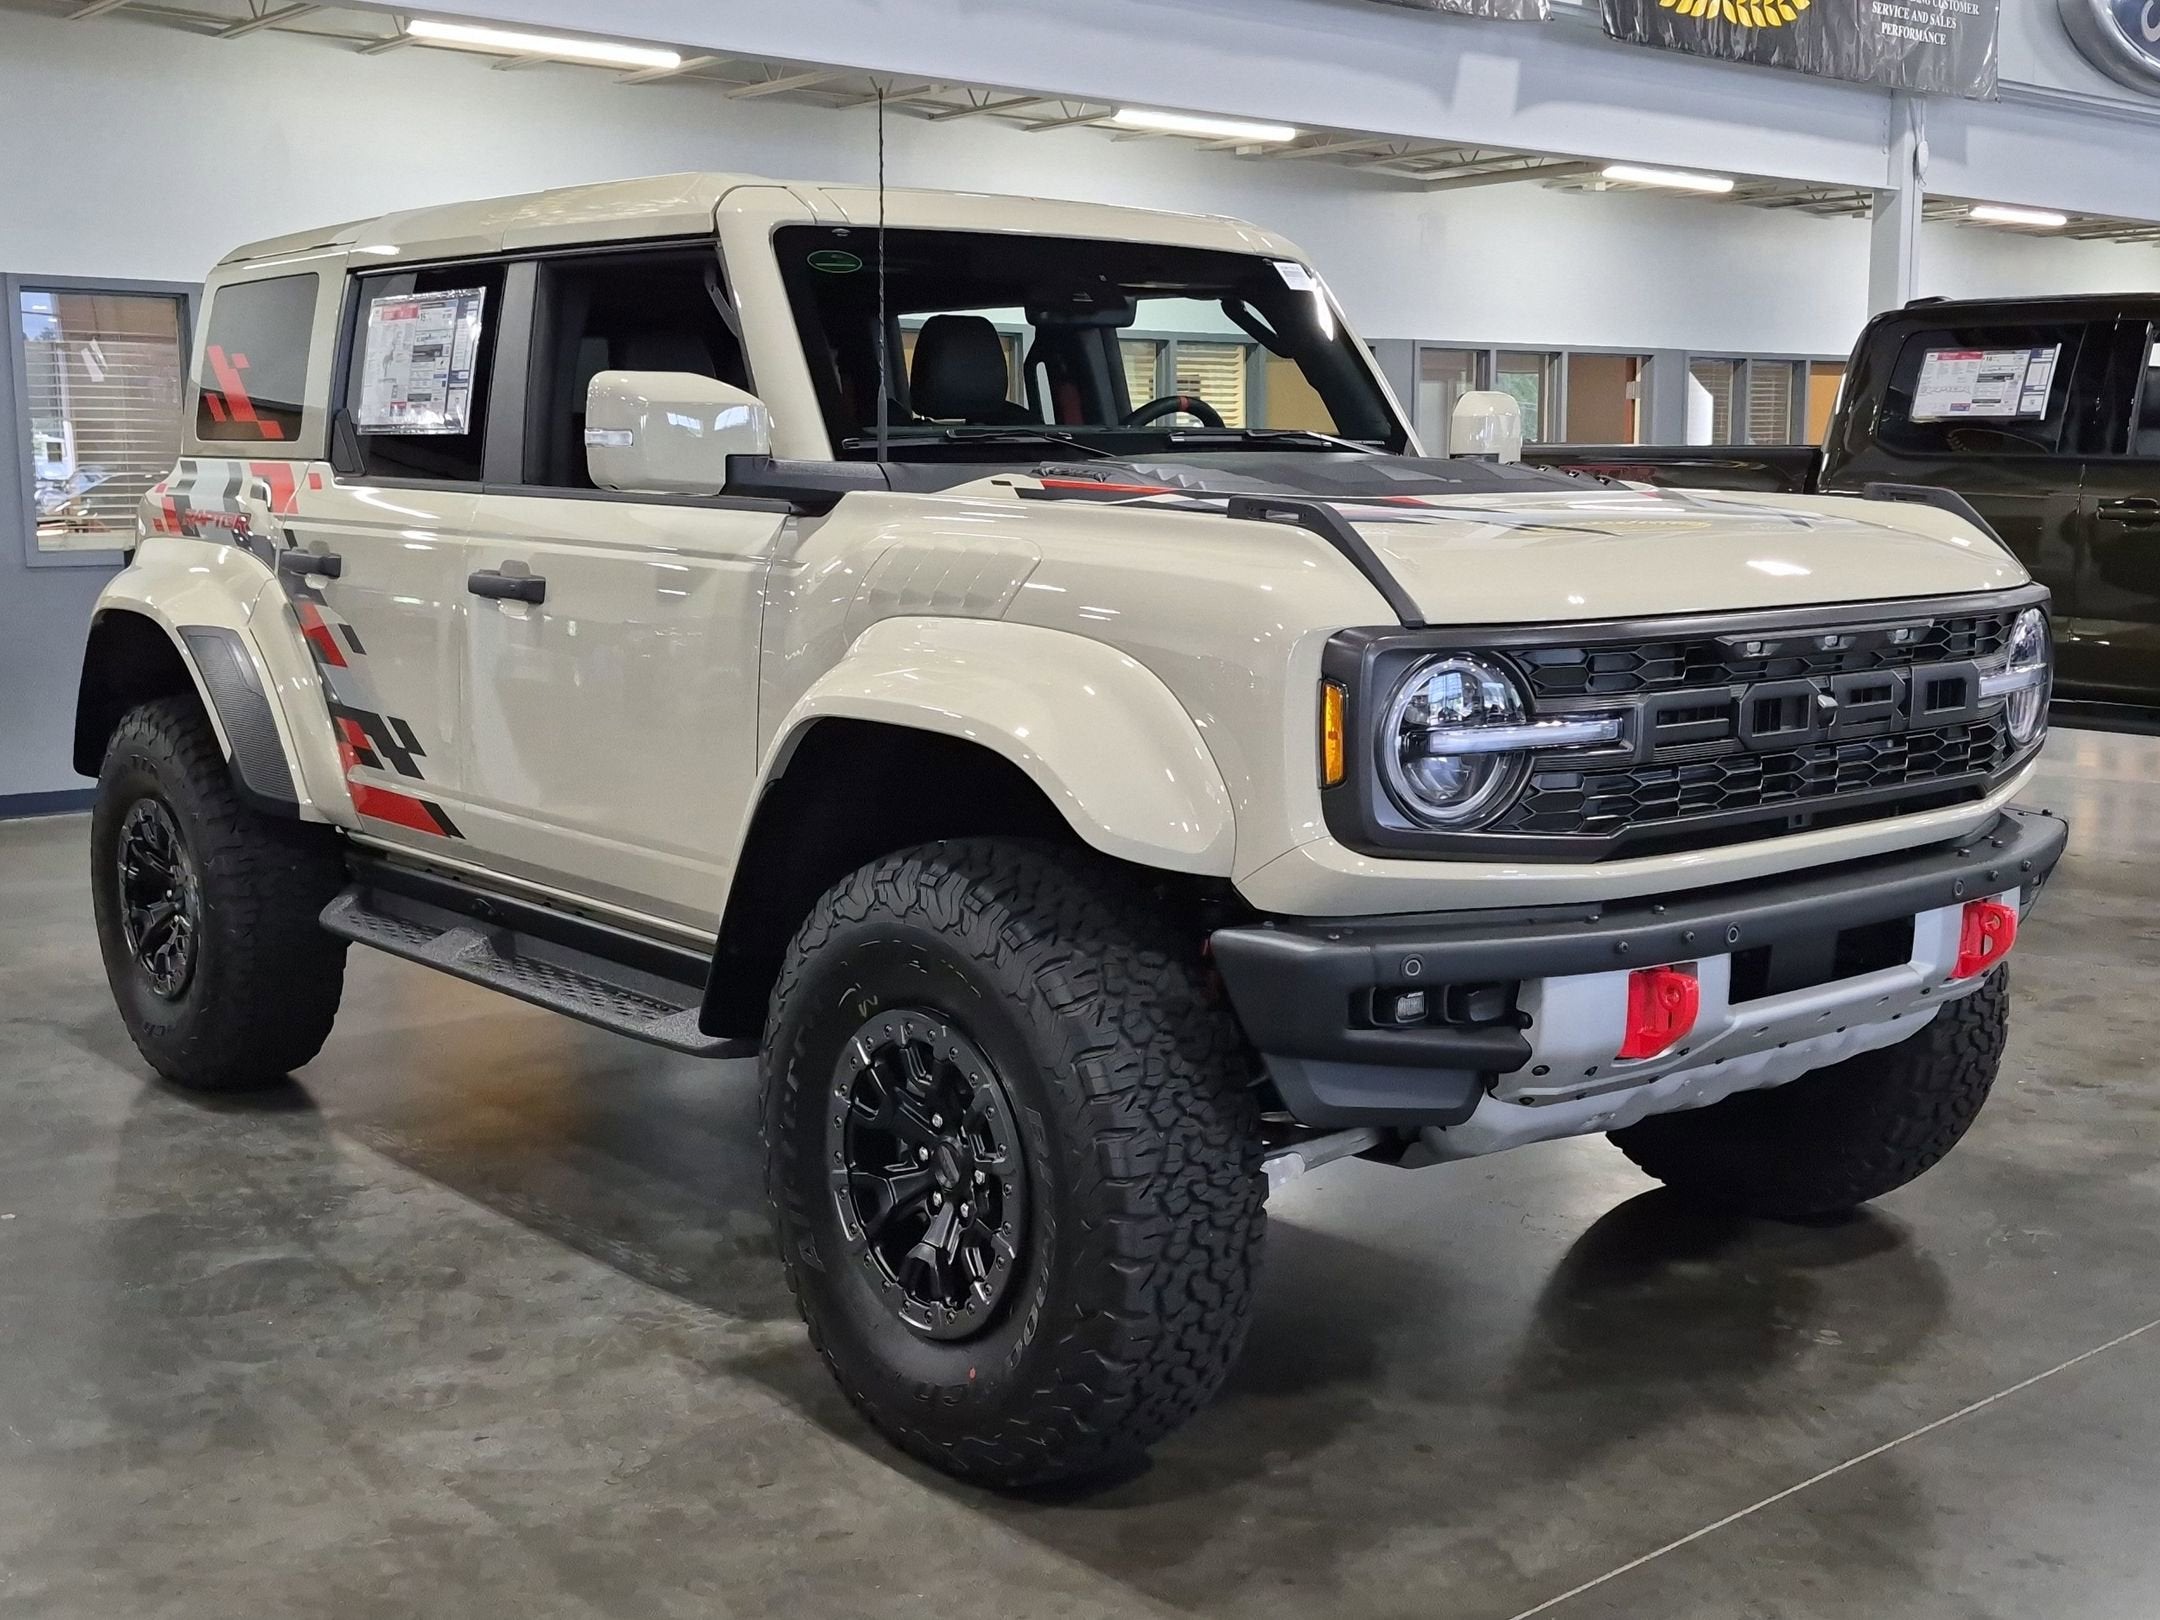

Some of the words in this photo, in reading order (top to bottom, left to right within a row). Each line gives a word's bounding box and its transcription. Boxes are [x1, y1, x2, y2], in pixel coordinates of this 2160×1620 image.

[1872, 1, 1910, 20] SERVICE
[1911, 10, 1929, 23] AND
[1930, 14, 1957, 29] SALES
[1932, 0, 1979, 15] CUSTOMER
[1881, 22, 1947, 45] PERFORMANCE
[1636, 660, 1980, 764] FORD
